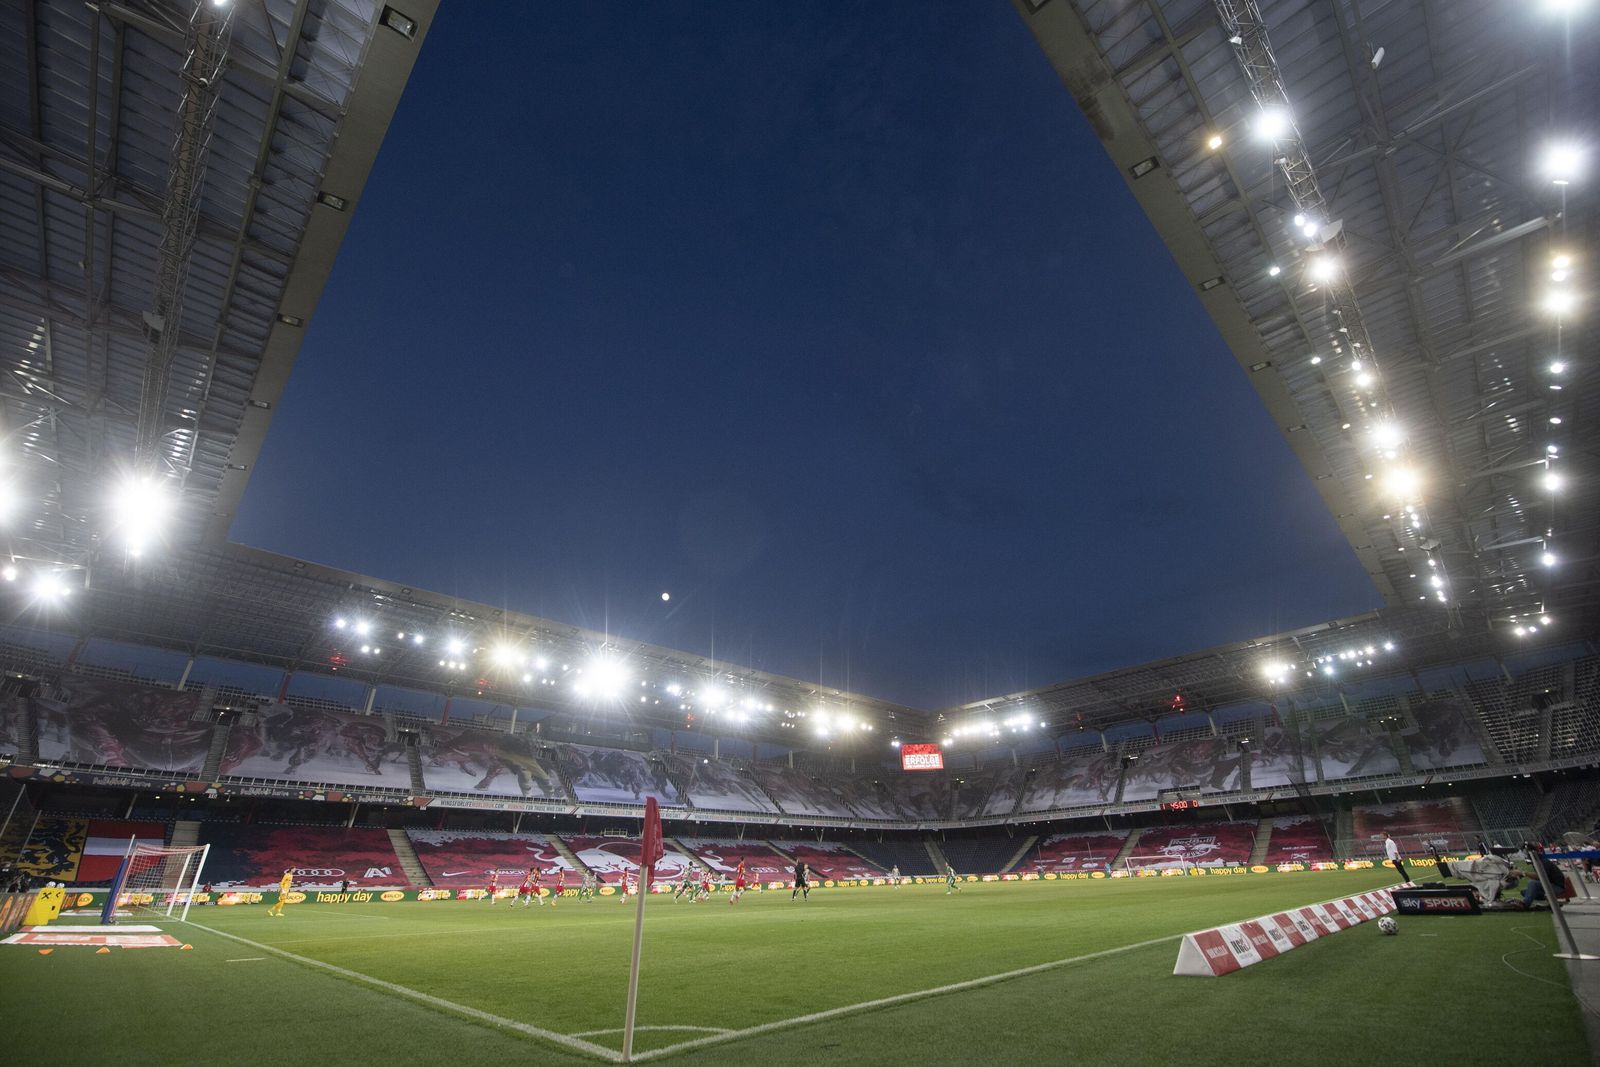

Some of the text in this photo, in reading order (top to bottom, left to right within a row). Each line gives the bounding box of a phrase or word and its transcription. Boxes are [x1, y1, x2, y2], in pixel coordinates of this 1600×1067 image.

[905, 756, 939, 766] ERFOLGE
[1409, 857, 1437, 867] happ
[1210, 866, 1247, 876] happy day
[316, 890, 373, 904] happy day
[1402, 897, 1466, 909] sky SPORT
